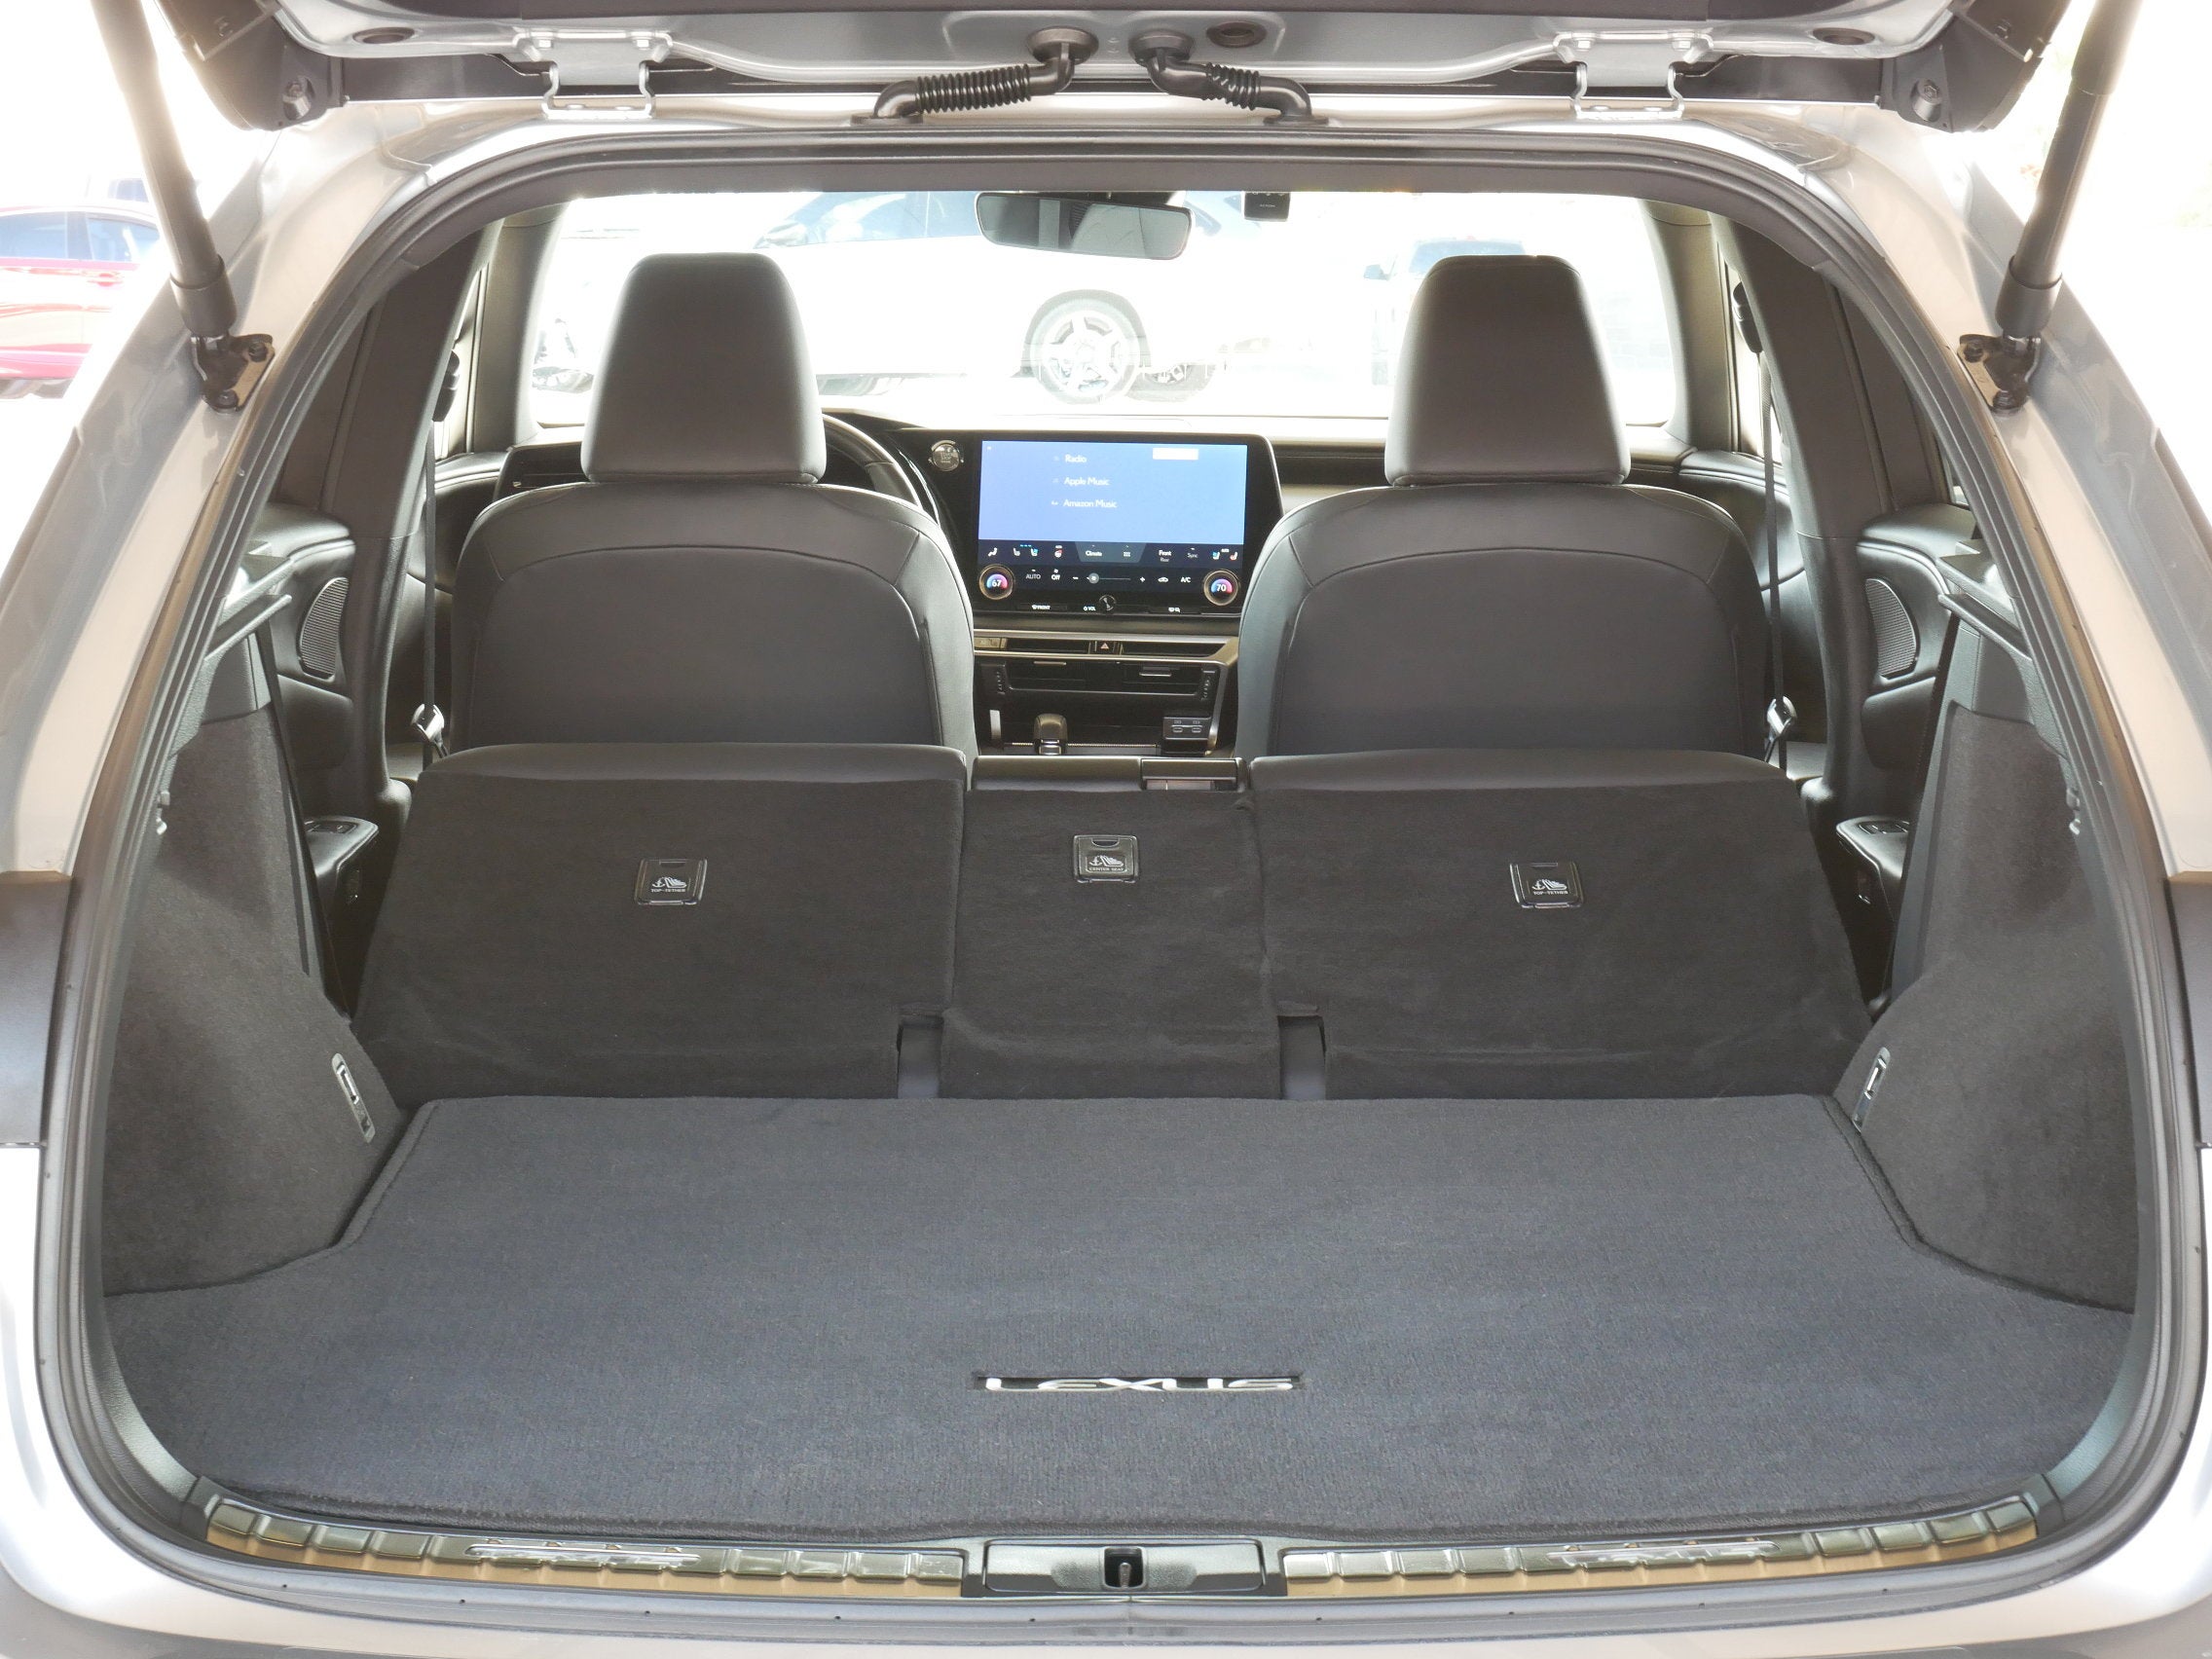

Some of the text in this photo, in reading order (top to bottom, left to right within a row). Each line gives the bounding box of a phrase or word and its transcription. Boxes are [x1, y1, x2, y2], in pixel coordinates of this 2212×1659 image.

[1065, 454, 1087, 462] Radio
[1063, 476, 1110, 486] Apple Music
[1062, 498, 1094, 507] Amazon
[991, 579, 1002, 588] 67
[984, 1377, 1294, 1392] LEXUS
